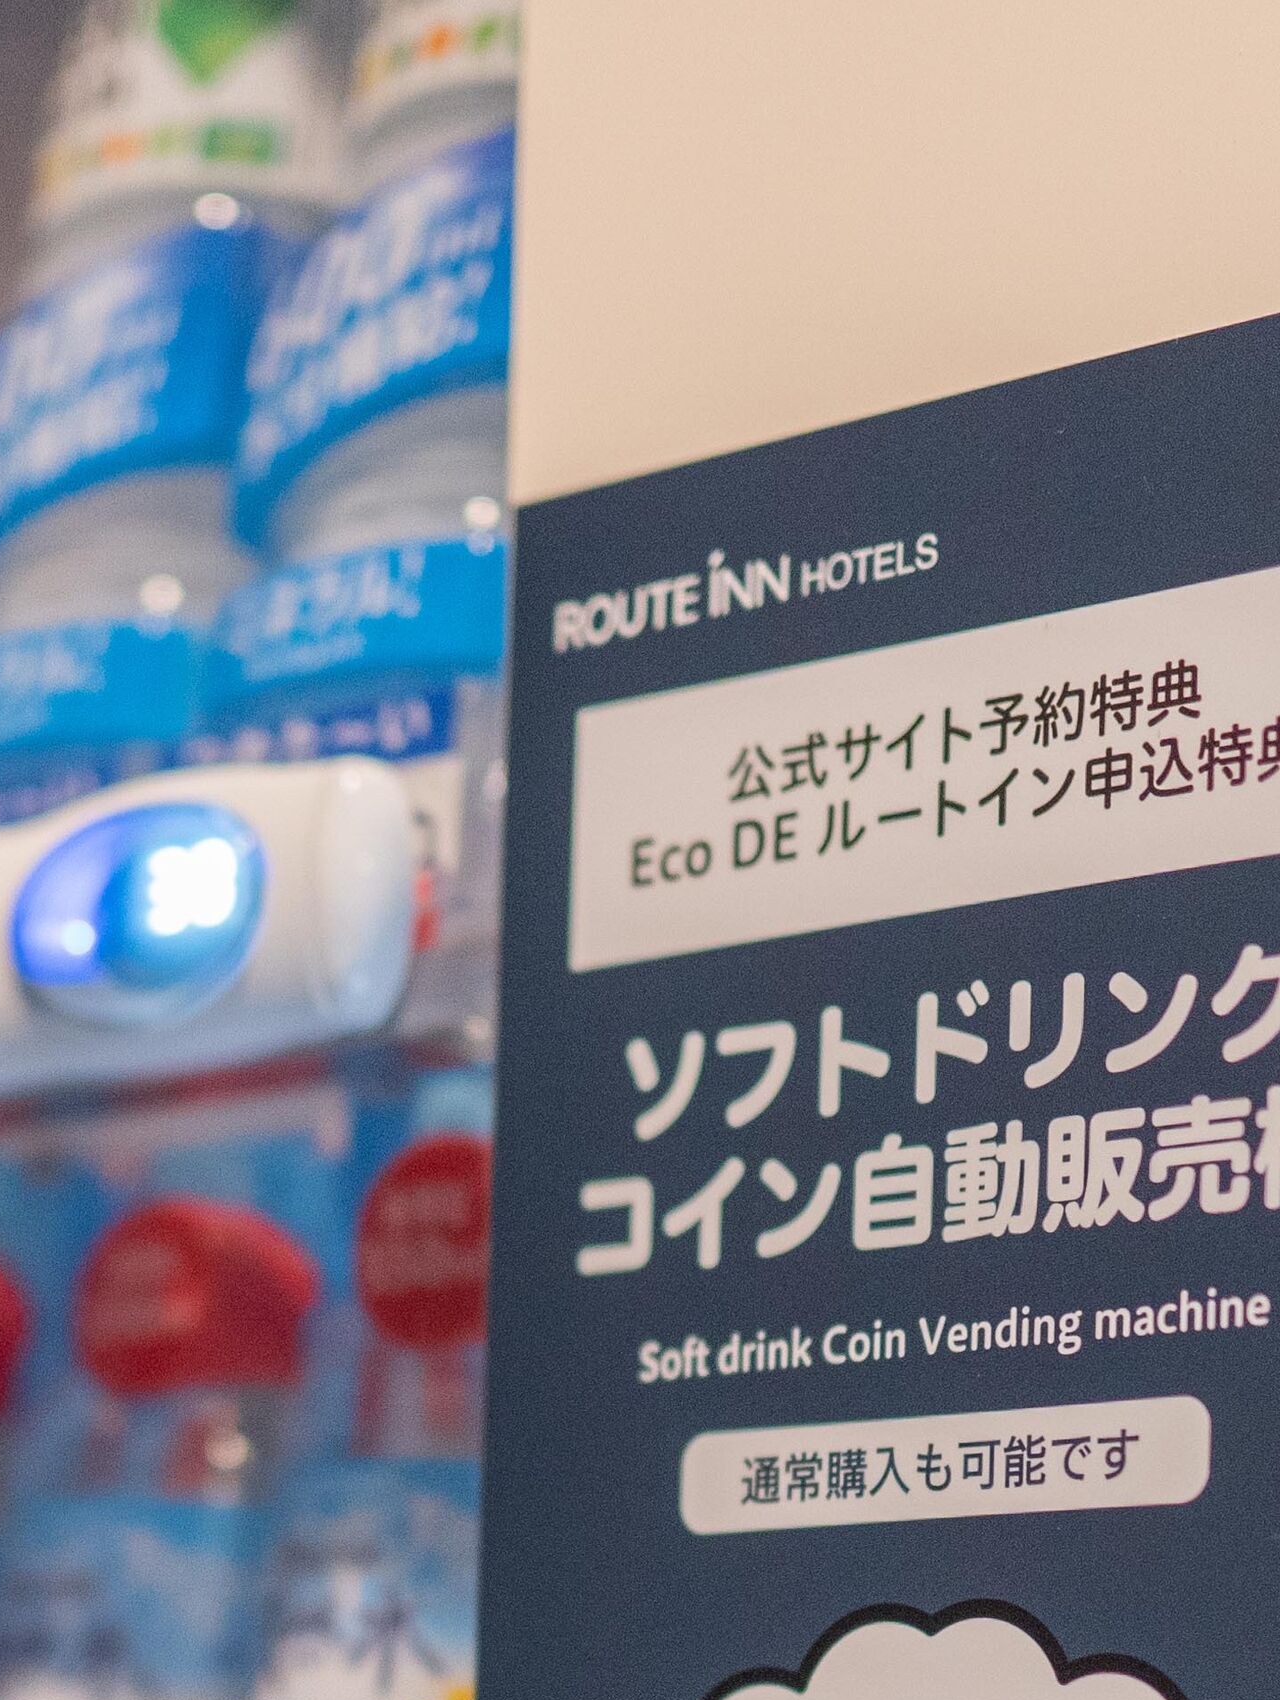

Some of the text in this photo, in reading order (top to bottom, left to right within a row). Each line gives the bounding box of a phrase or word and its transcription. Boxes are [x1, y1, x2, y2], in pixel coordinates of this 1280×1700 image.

[552, 574, 700, 655] ROUTE
[801, 532, 940, 598] HOTELS
[727, 659, 1202, 803] 公式サイト予約特典
[630, 838, 713, 889] Eco
[732, 811, 798, 870] DE
[625, 943, 1280, 1142] ソフトドリンク
[576, 1084, 1280, 1277] コイン自動販売
[638, 1287, 1272, 1385] Soft drink Coin Vending machine
[740, 1428, 1141, 1506] 通常購入も可能です
